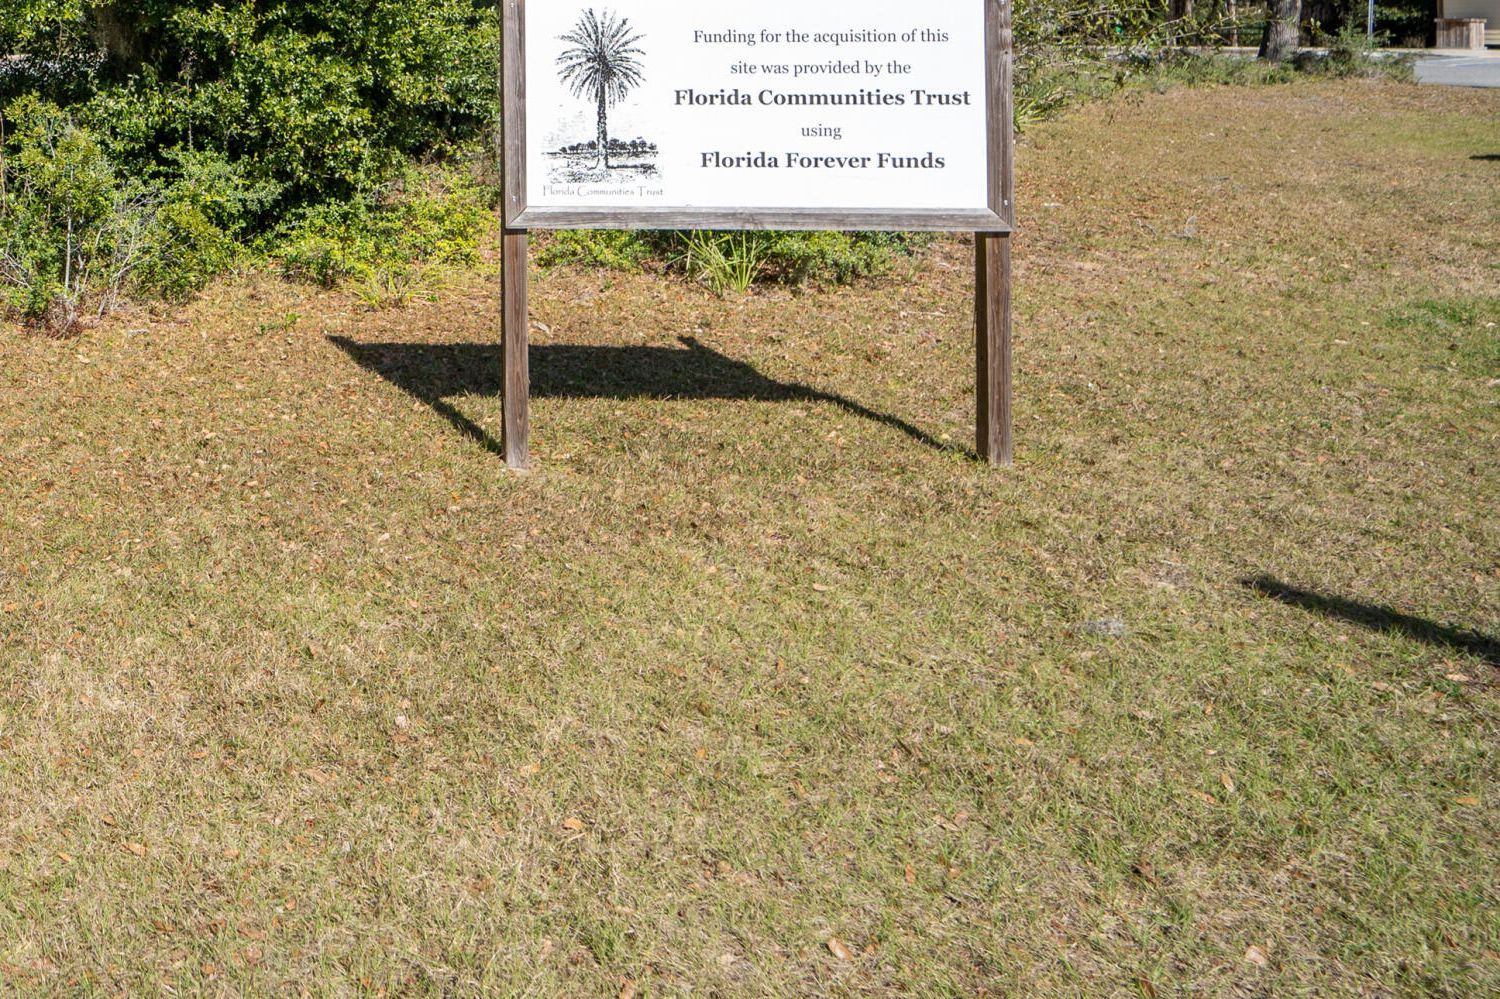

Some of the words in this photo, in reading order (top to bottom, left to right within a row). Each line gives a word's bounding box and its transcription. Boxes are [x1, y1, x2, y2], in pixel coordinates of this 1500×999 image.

[693, 29, 756, 46] Funding
[760, 29, 781, 43] for
[785, 29, 809, 43] the
[813, 29, 897, 46] acquisition
[901, 28, 918, 42] of
[921, 28, 949, 42] this
[730, 60, 757, 74] site
[761, 63, 789, 74] was
[793, 60, 860, 77] provided
[864, 60, 883, 77] by
[886, 60, 911, 74] the
[674, 89, 752, 106] Florida
[758, 89, 905, 106] Communities
[911, 89, 971, 106] Trust
[801, 124, 842, 140] using
[700, 151, 779, 168] Florida
[785, 152, 871, 168] Forever
[877, 151, 946, 168] Funds
[543, 185, 575, 197] Florida
[577, 185, 635, 197] Communities
[637, 185, 663, 197] Trust
